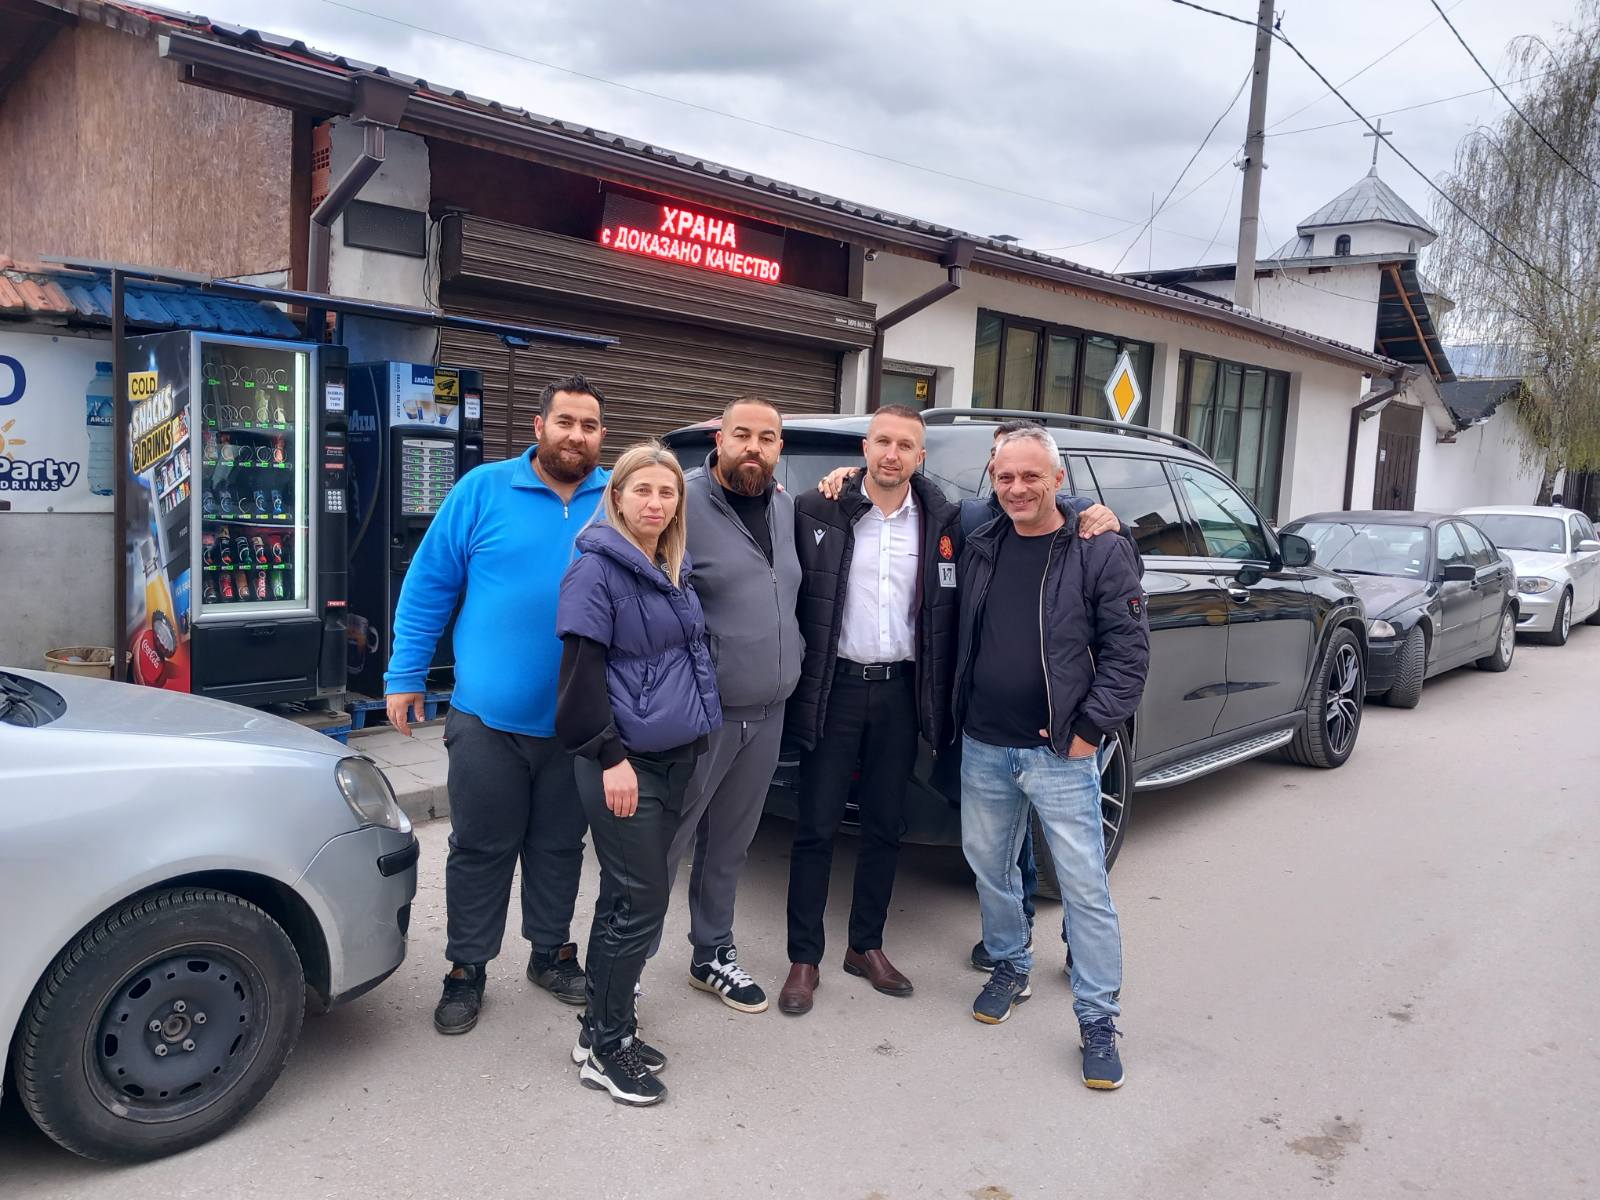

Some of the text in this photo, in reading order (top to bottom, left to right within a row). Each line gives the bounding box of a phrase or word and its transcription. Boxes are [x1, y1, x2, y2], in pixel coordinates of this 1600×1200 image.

[660, 206, 736, 248] ХРАНА
[614, 226, 702, 264] ДОКАЗАНО
[705, 247, 780, 281] КАЧЕСТВО
[132, 378, 156, 395] COLD
[132, 384, 172, 441] SNACKS
[133, 422, 171, 472] & DRINKS
[0, 480, 59, 490] DRINKS
